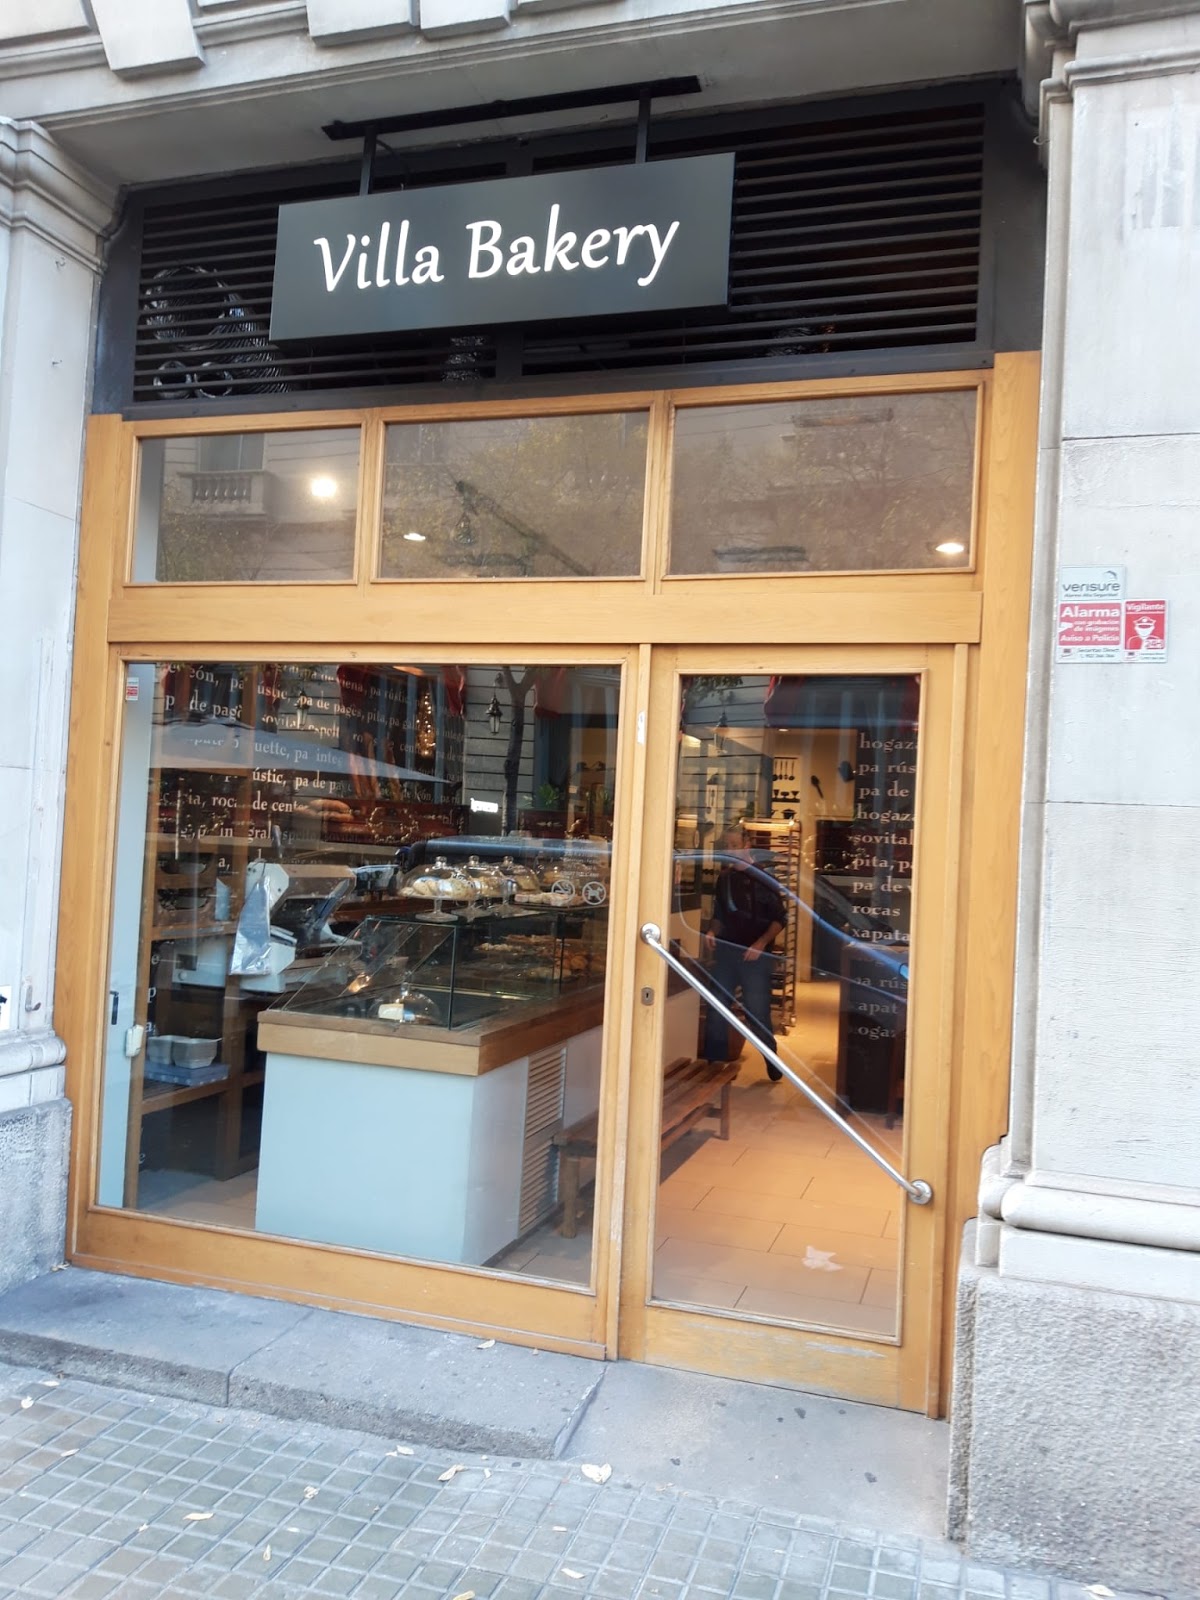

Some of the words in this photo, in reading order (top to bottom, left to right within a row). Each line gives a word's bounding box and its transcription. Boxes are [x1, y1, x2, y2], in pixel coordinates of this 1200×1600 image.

[313, 219, 445, 292] Villa
[465, 203, 681, 287] Bakery
[1062, 582, 1121, 592] verisure
[1061, 605, 1120, 618] Alarma
[1060, 634, 1083, 642] Aviso
[189, 665, 219, 687] eón,
[229, 677, 244, 692] pa
[257, 681, 291, 703] ústic,
[316, 690, 330, 710] de
[189, 688, 207, 712] de
[211, 703, 243, 722] pagè
[860, 732, 915, 753] hogaz
[293, 749, 308, 763] pa
[858, 763, 880, 776] pa
[887, 761, 916, 774] rús
[252, 767, 286, 787] ústic,
[295, 775, 309, 792] pa
[312, 769, 326, 789] de
[859, 786, 880, 799] pa
[887, 780, 910, 797] de
[211, 796, 237, 808] roc
[252, 789, 268, 811] de
[857, 803, 913, 824] hogaz
[853, 855, 894, 871] pita,
[898, 859, 913, 873] p
[852, 881, 875, 894] pa
[880, 875, 904, 893] de
[851, 903, 901, 917] rocas
[880, 976, 908, 990] rús
[857, 1001, 899, 1016] apat
